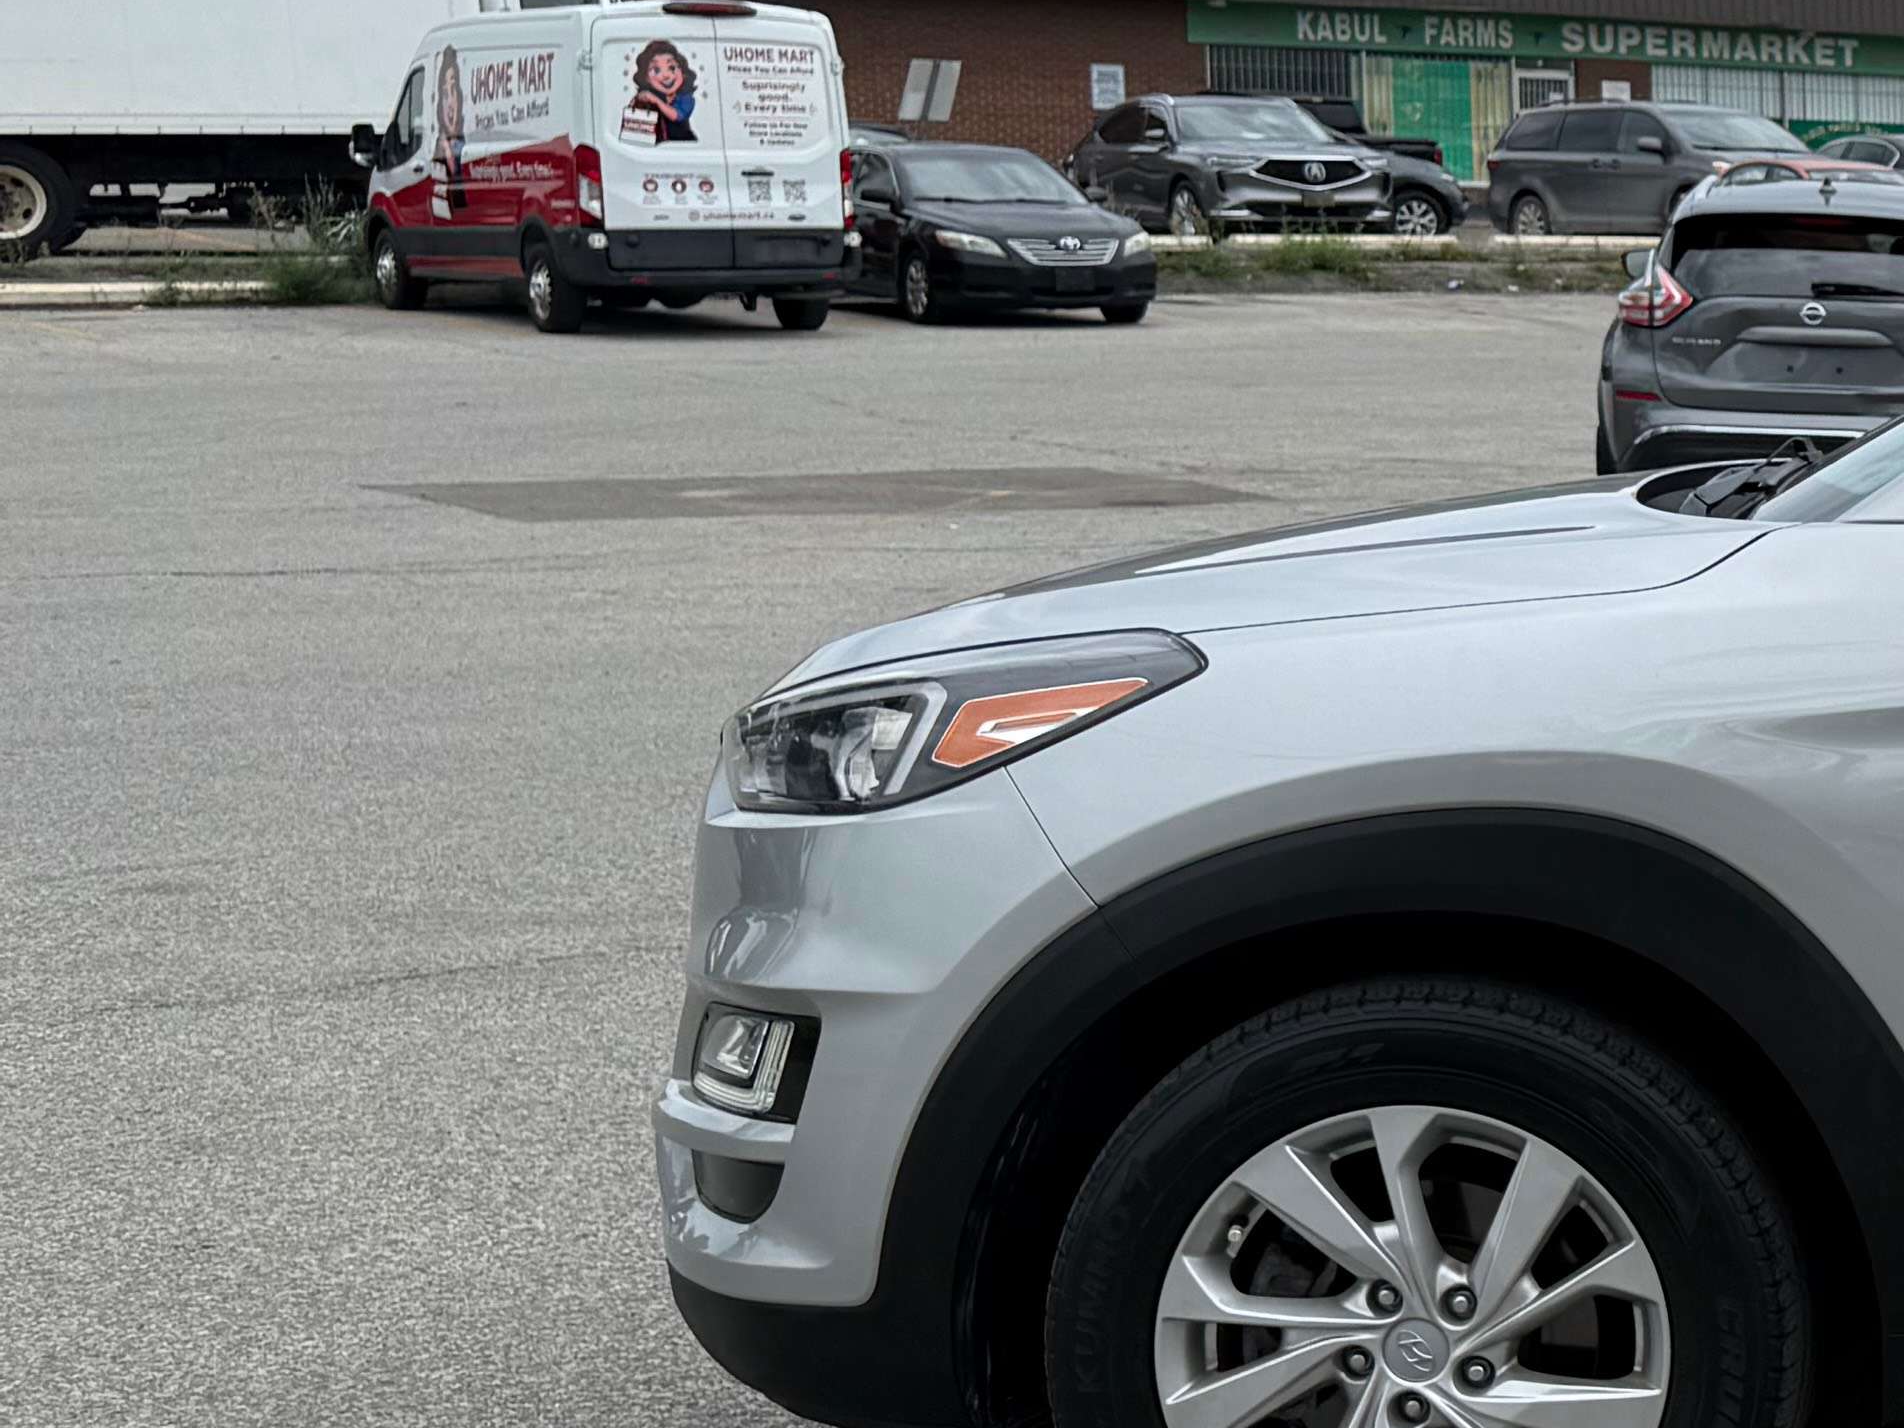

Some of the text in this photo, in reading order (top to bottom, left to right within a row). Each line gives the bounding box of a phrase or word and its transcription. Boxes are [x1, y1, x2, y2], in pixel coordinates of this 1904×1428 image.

[723, 46, 814, 64] UHOME MART
[1297, 10, 1860, 68] KABUL FARMS SUPERMARKET
[470, 52, 555, 105] UHOME MART
